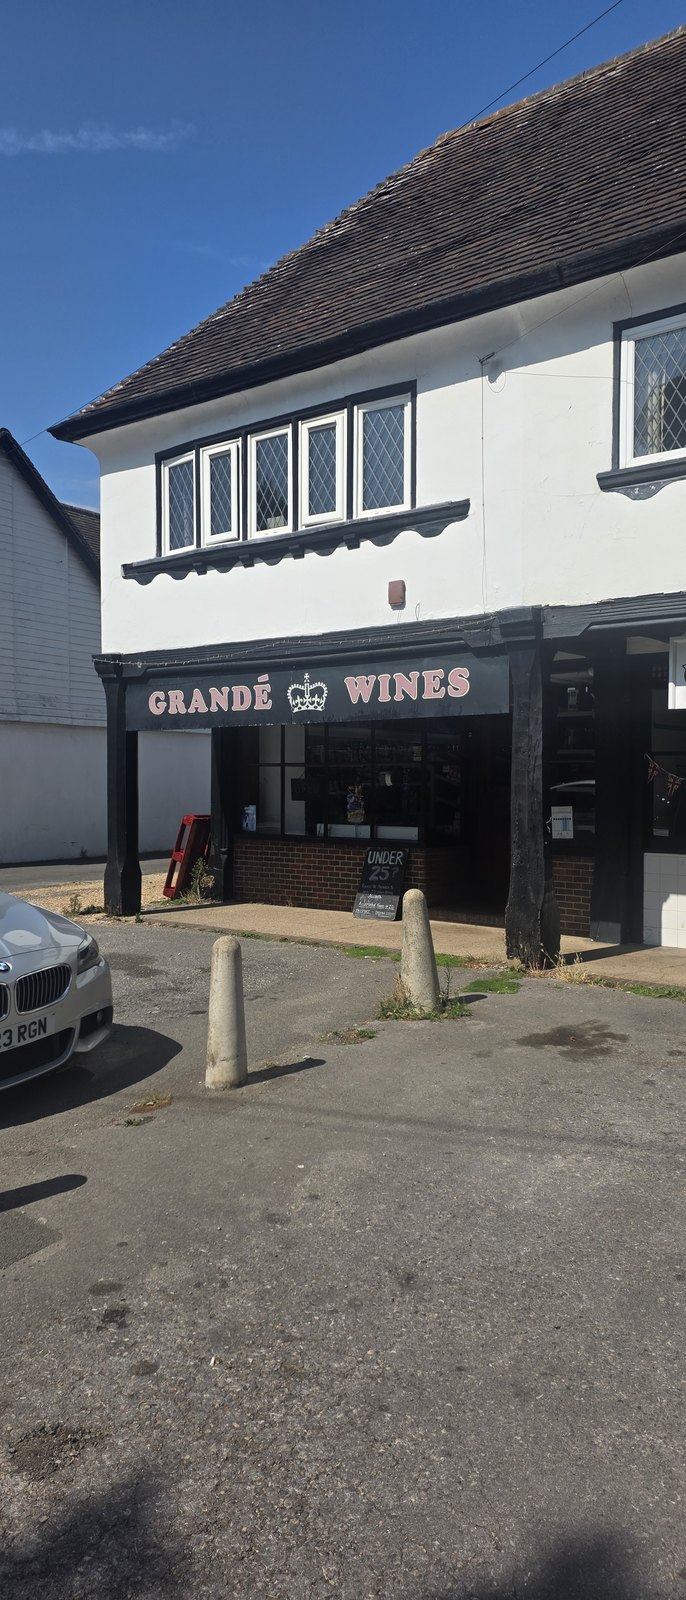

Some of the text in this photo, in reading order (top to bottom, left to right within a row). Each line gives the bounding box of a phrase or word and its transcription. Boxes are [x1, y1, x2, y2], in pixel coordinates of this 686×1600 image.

[148, 667, 471, 715] GRANDÉ WINES
[367, 851, 403, 864] UNDER
[0, 1017, 47, 1048] 3 RGN
